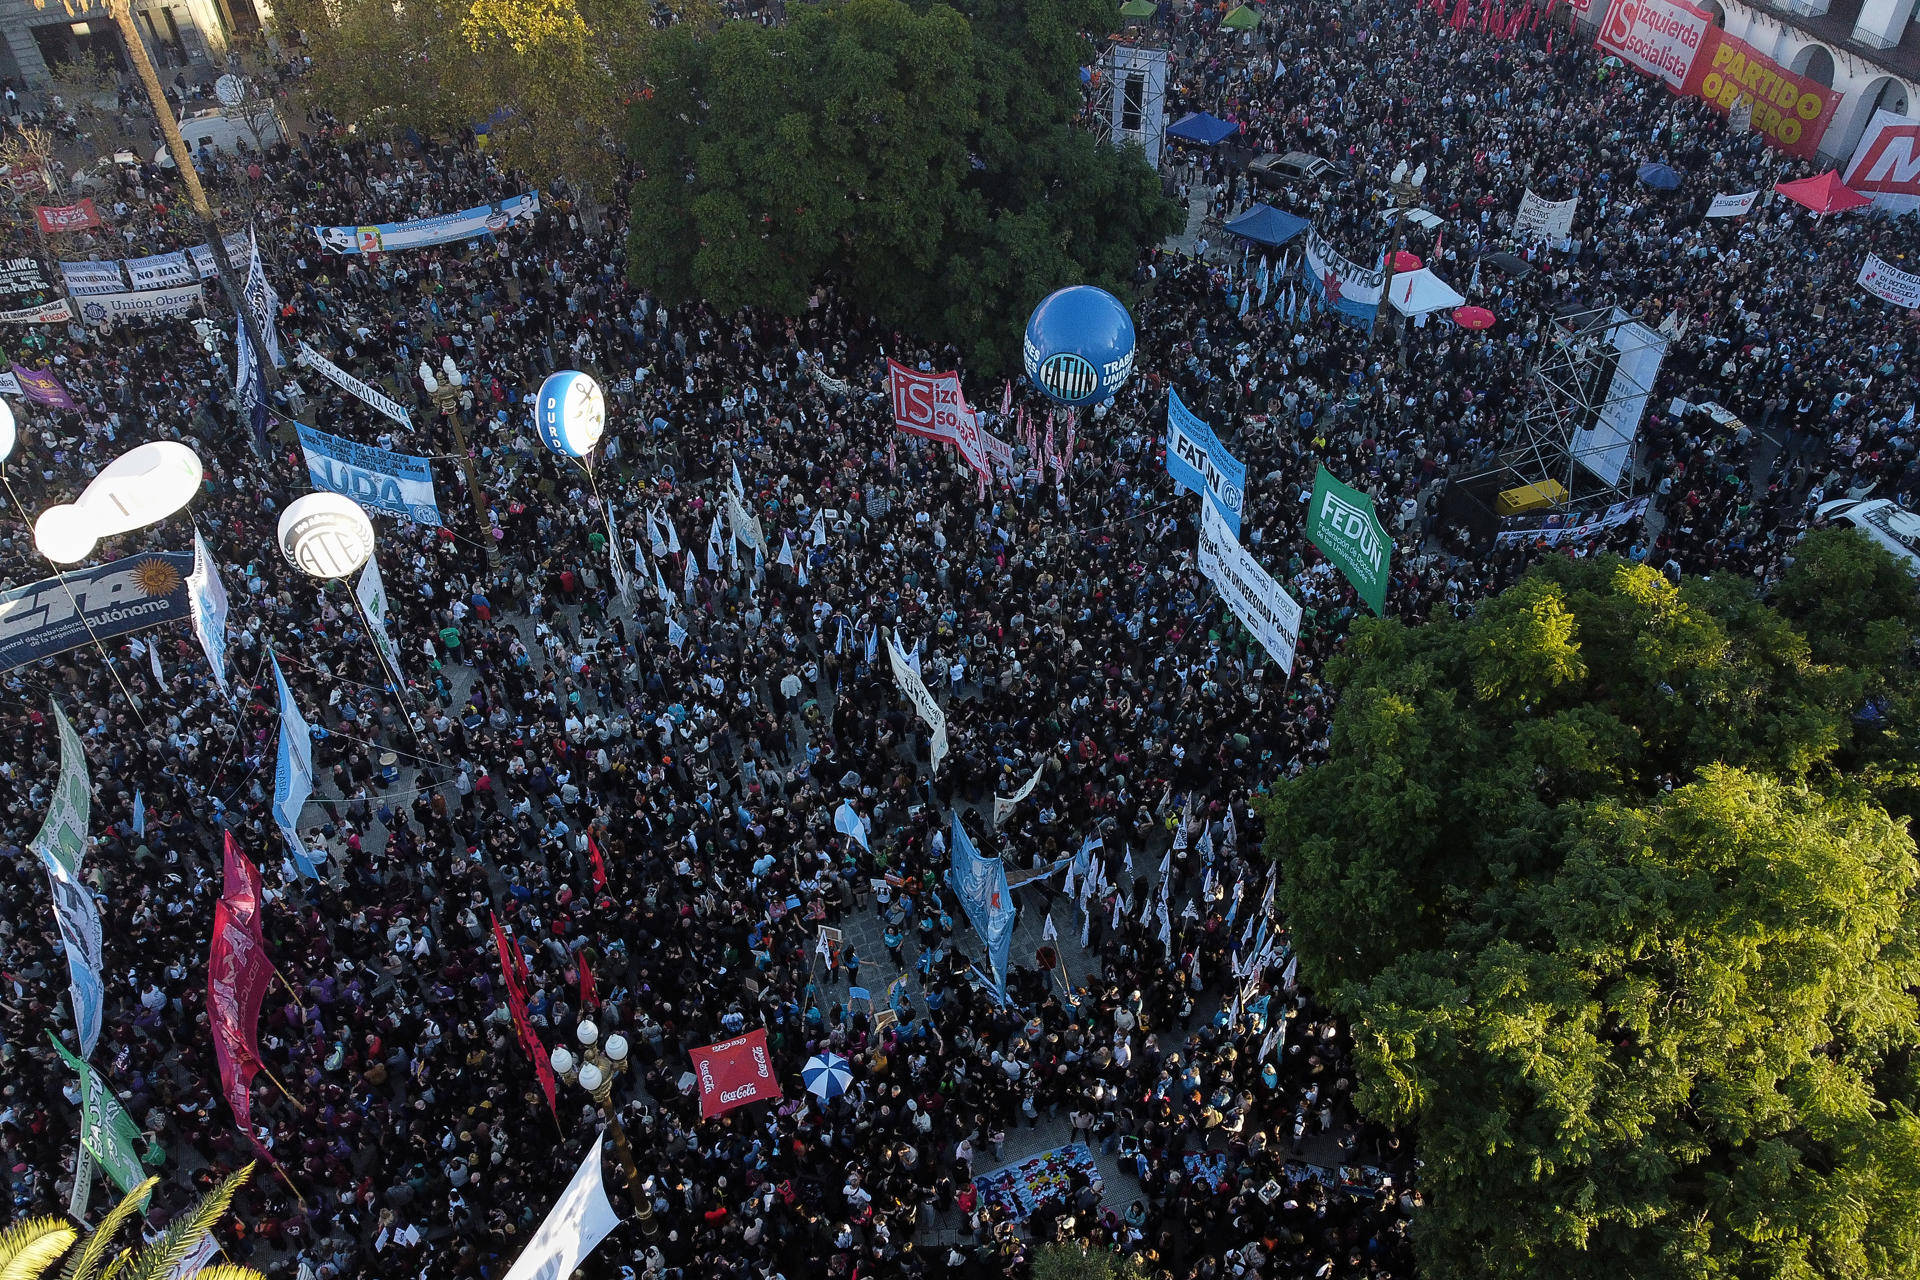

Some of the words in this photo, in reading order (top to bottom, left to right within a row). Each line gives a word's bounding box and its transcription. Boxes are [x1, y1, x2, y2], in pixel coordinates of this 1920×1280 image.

[1637, 3, 1700, 49] izquierda
[1627, 35, 1687, 80] socialista
[1711, 42, 1823, 120] PARTIDO
[1864, 136, 1920, 184] M
[136, 270, 154, 280] NO
[160, 265, 182, 276] HAY
[110, 298, 153, 311] Unión
[155, 292, 198, 307] Obrera
[1044, 357, 1094, 399] FATUN
[324, 459, 410, 512] UDA
[300, 531, 360, 576] ATE
[1318, 522, 1350, 550] Federación
[1320, 490, 1382, 573] FEDUN
[1239, 558, 1270, 593] conadu
[1316, 530, 1324, 541] de
[1324, 536, 1334, 548] las
[1332, 541, 1368, 584] Universidades
[88, 600, 170, 628] autónoma
[1231, 574, 1272, 623] UNIVERSIDAD
[0, 638, 25, 652] entral
